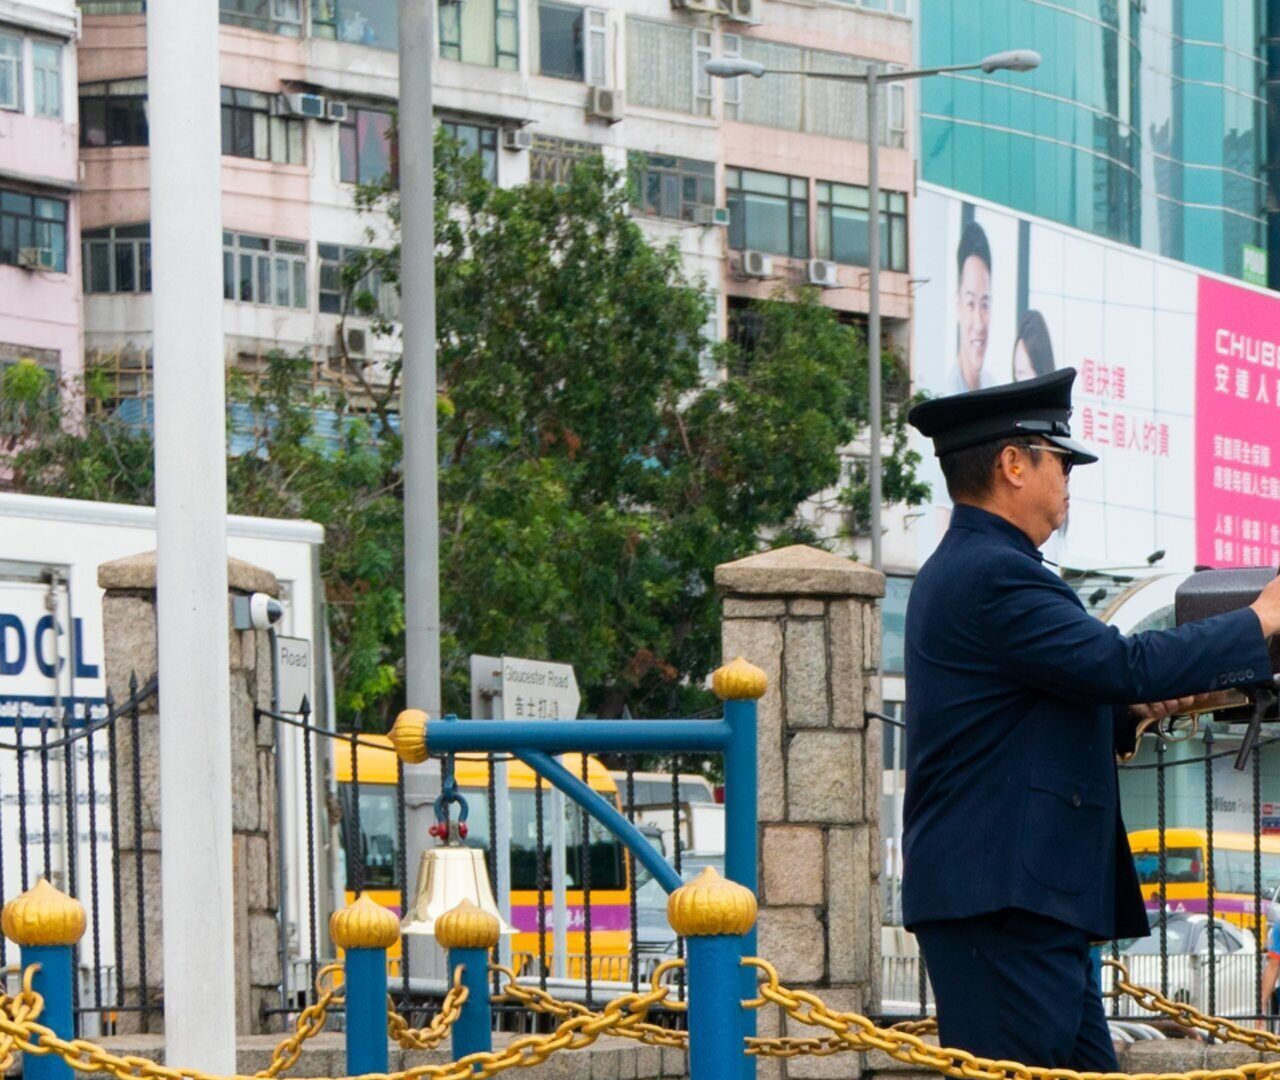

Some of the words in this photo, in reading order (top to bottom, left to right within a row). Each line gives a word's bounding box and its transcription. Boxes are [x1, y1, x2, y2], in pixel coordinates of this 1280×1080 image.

[0, 613, 99, 679] DCL
[280, 647, 307, 668] Road
[505, 665, 546, 685] Gloucester
[547, 670, 569, 689] Road
[515, 695, 559, 720] 告士打道
